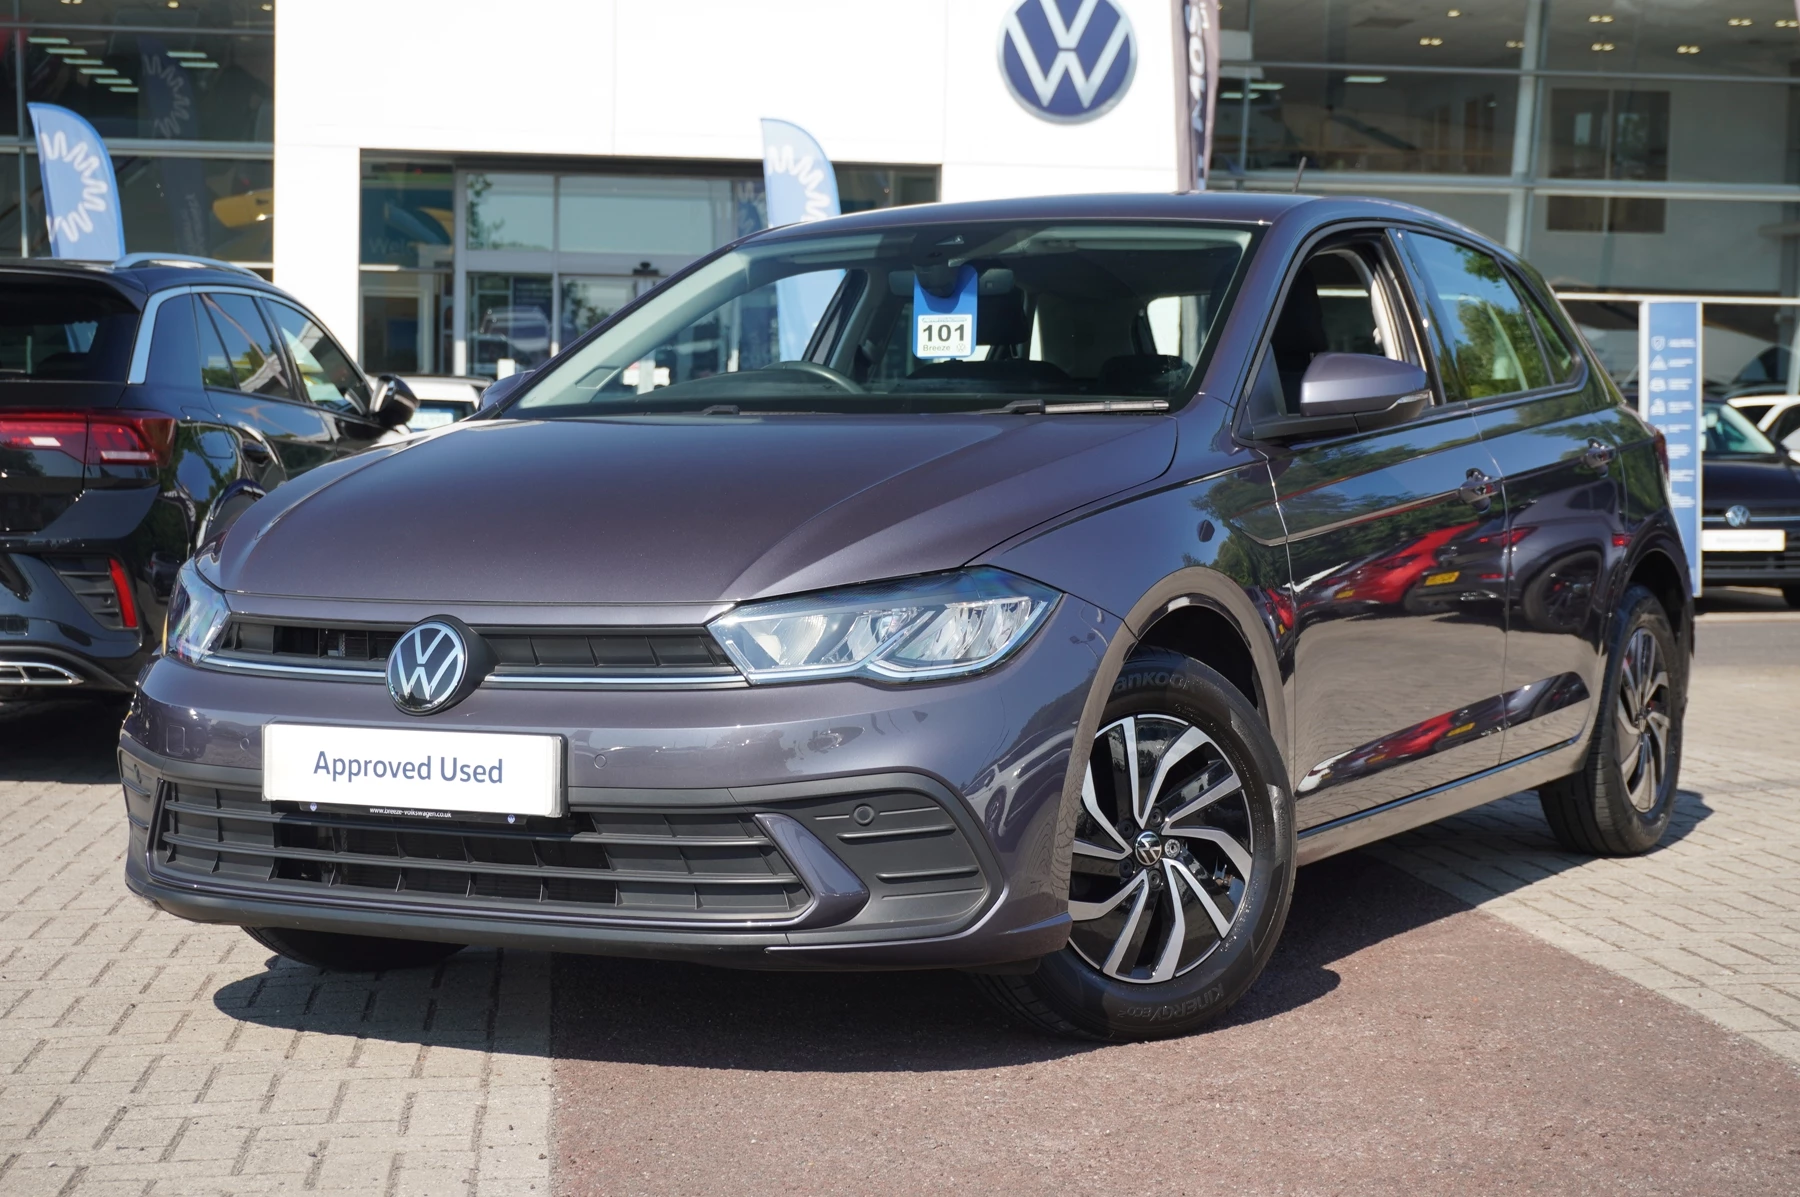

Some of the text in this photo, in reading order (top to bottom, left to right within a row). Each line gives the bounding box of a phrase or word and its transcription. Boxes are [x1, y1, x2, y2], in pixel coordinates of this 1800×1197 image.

[998, 0, 1136, 117] VW
[922, 323, 965, 343] 101
[922, 344, 951, 352] Breeze
[389, 623, 463, 706] VW
[313, 751, 503, 784] Approved Used
[369, 806, 452, 819] www.breeze-volkswagen.co.uk
